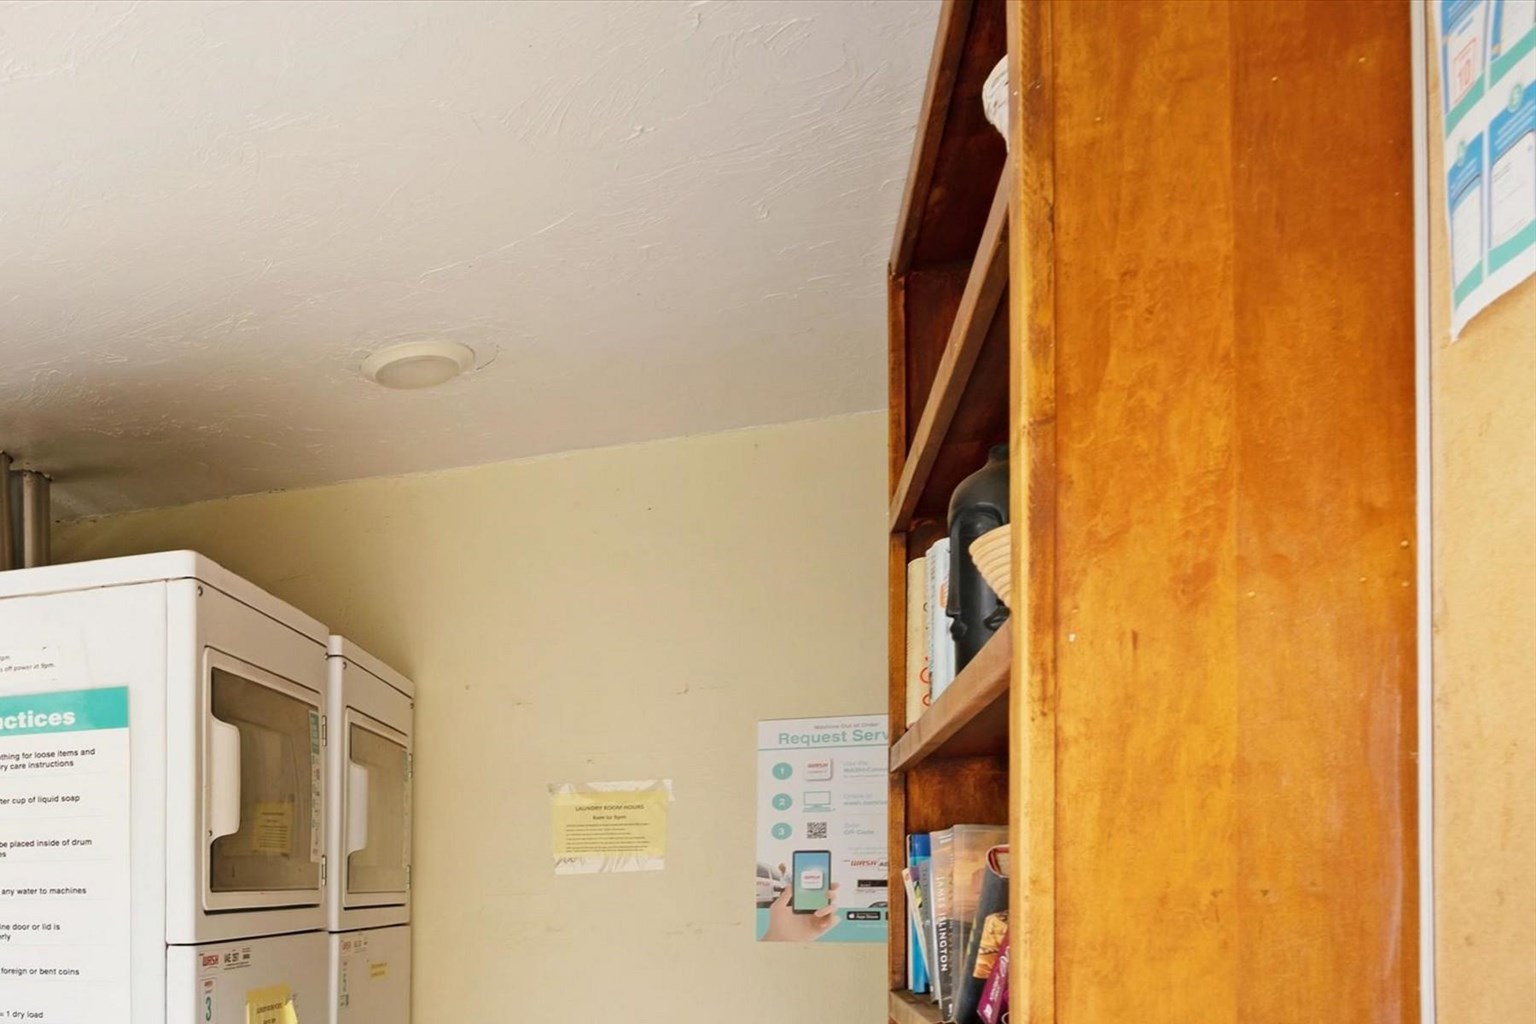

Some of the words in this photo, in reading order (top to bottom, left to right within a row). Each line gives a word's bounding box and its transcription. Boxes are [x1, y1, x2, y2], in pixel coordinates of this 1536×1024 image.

[778, 731, 847, 746] Request
[35, 751, 55, 759] loose
[81, 748, 95, 756] and
[28, 759, 74, 769] instructions
[10, 841, 34, 849] placed
[1, 968, 27, 976] foreign
[205, 996, 212, 1021] 3
[13, 1011, 25, 1019] dry
